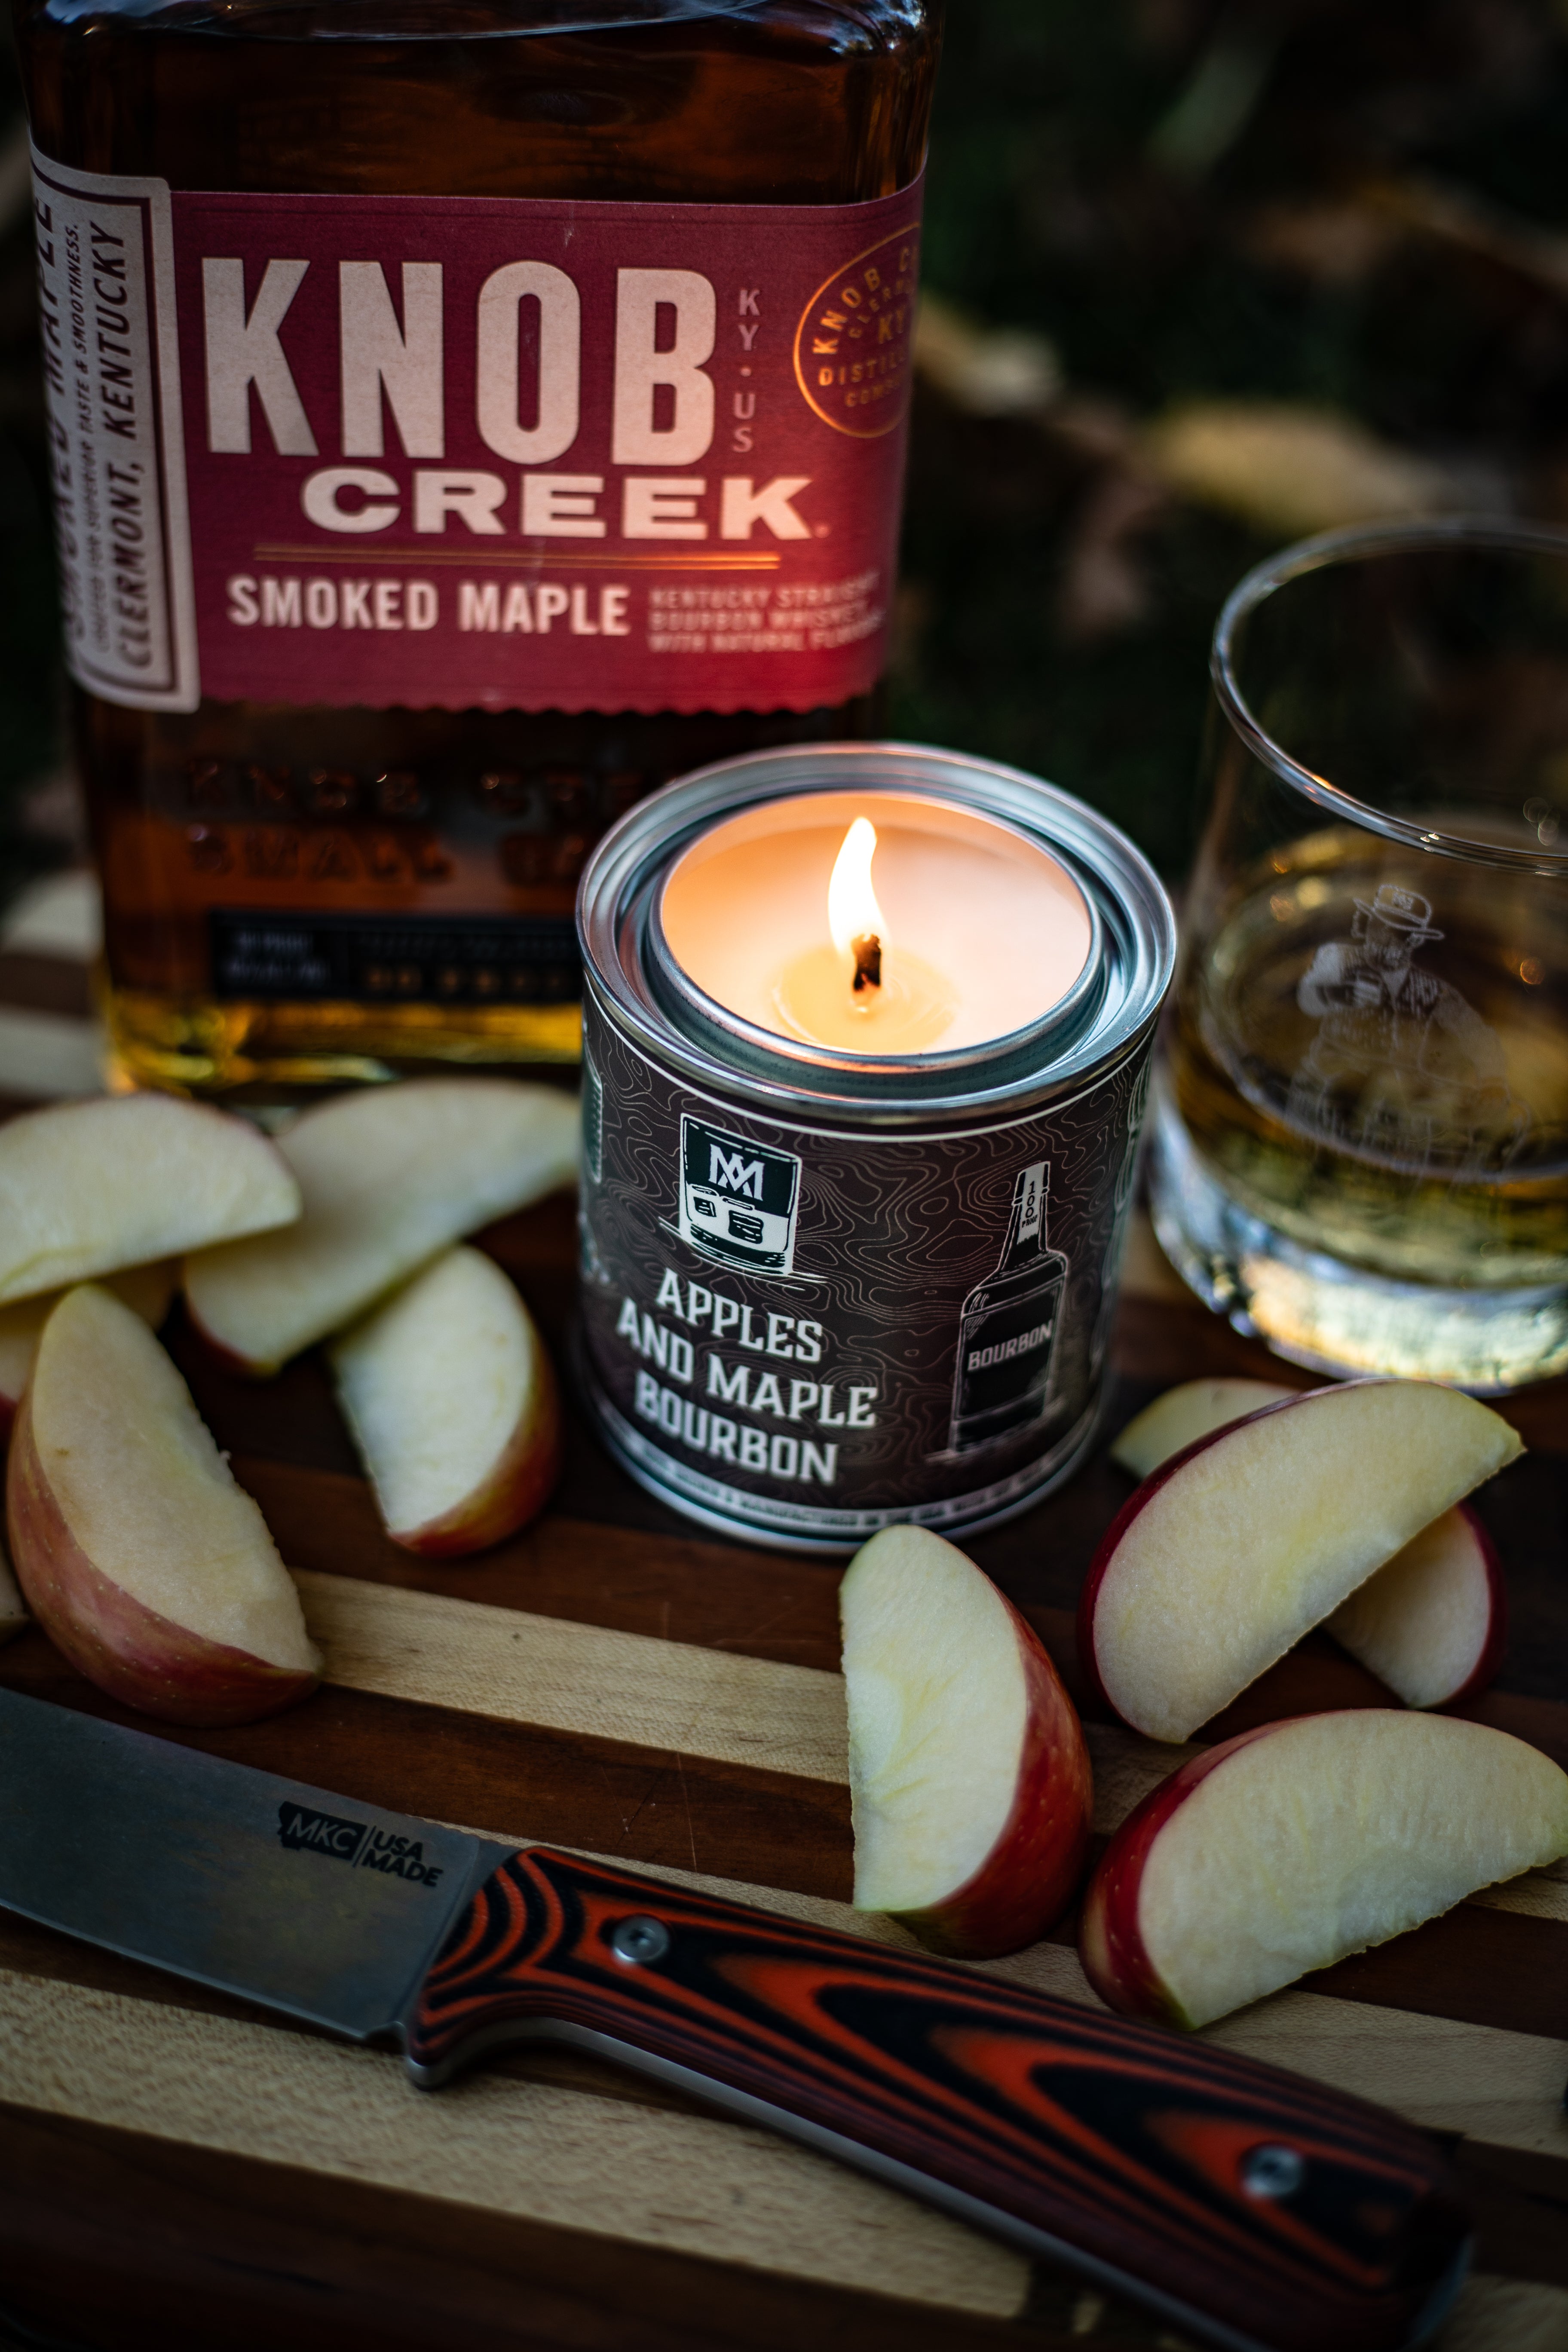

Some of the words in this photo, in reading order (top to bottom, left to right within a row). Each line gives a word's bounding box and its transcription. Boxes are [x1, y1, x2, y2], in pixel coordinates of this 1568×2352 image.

[65, 223, 87, 355] SMOOTHNESS.
[812, 267, 881, 355] KNOB
[90, 220, 137, 440] KENTUCKY
[202, 258, 717, 466] KNOB
[75, 358, 89, 375] &
[77, 378, 94, 433] TASTE
[302, 466, 812, 540] CREEK
[107, 462, 152, 668] CLERMONT,
[227, 573, 439, 631] SMOKED
[458, 578, 631, 636] MAPLE
[1022, 1214, 1038, 1228] PROOF
[1025, 1180, 1035, 1219] 100
[656, 1267, 823, 1363] APPLES
[968, 1319, 1053, 1372] BOURBON
[616, 1298, 694, 1384] AND
[706, 1353, 877, 1428] MAPLE
[635, 1370, 839, 1485] BOURBON
[287, 1813, 357, 1851] MKC
[373, 1831, 424, 1862] USA
[362, 1849, 444, 1887] MADE
